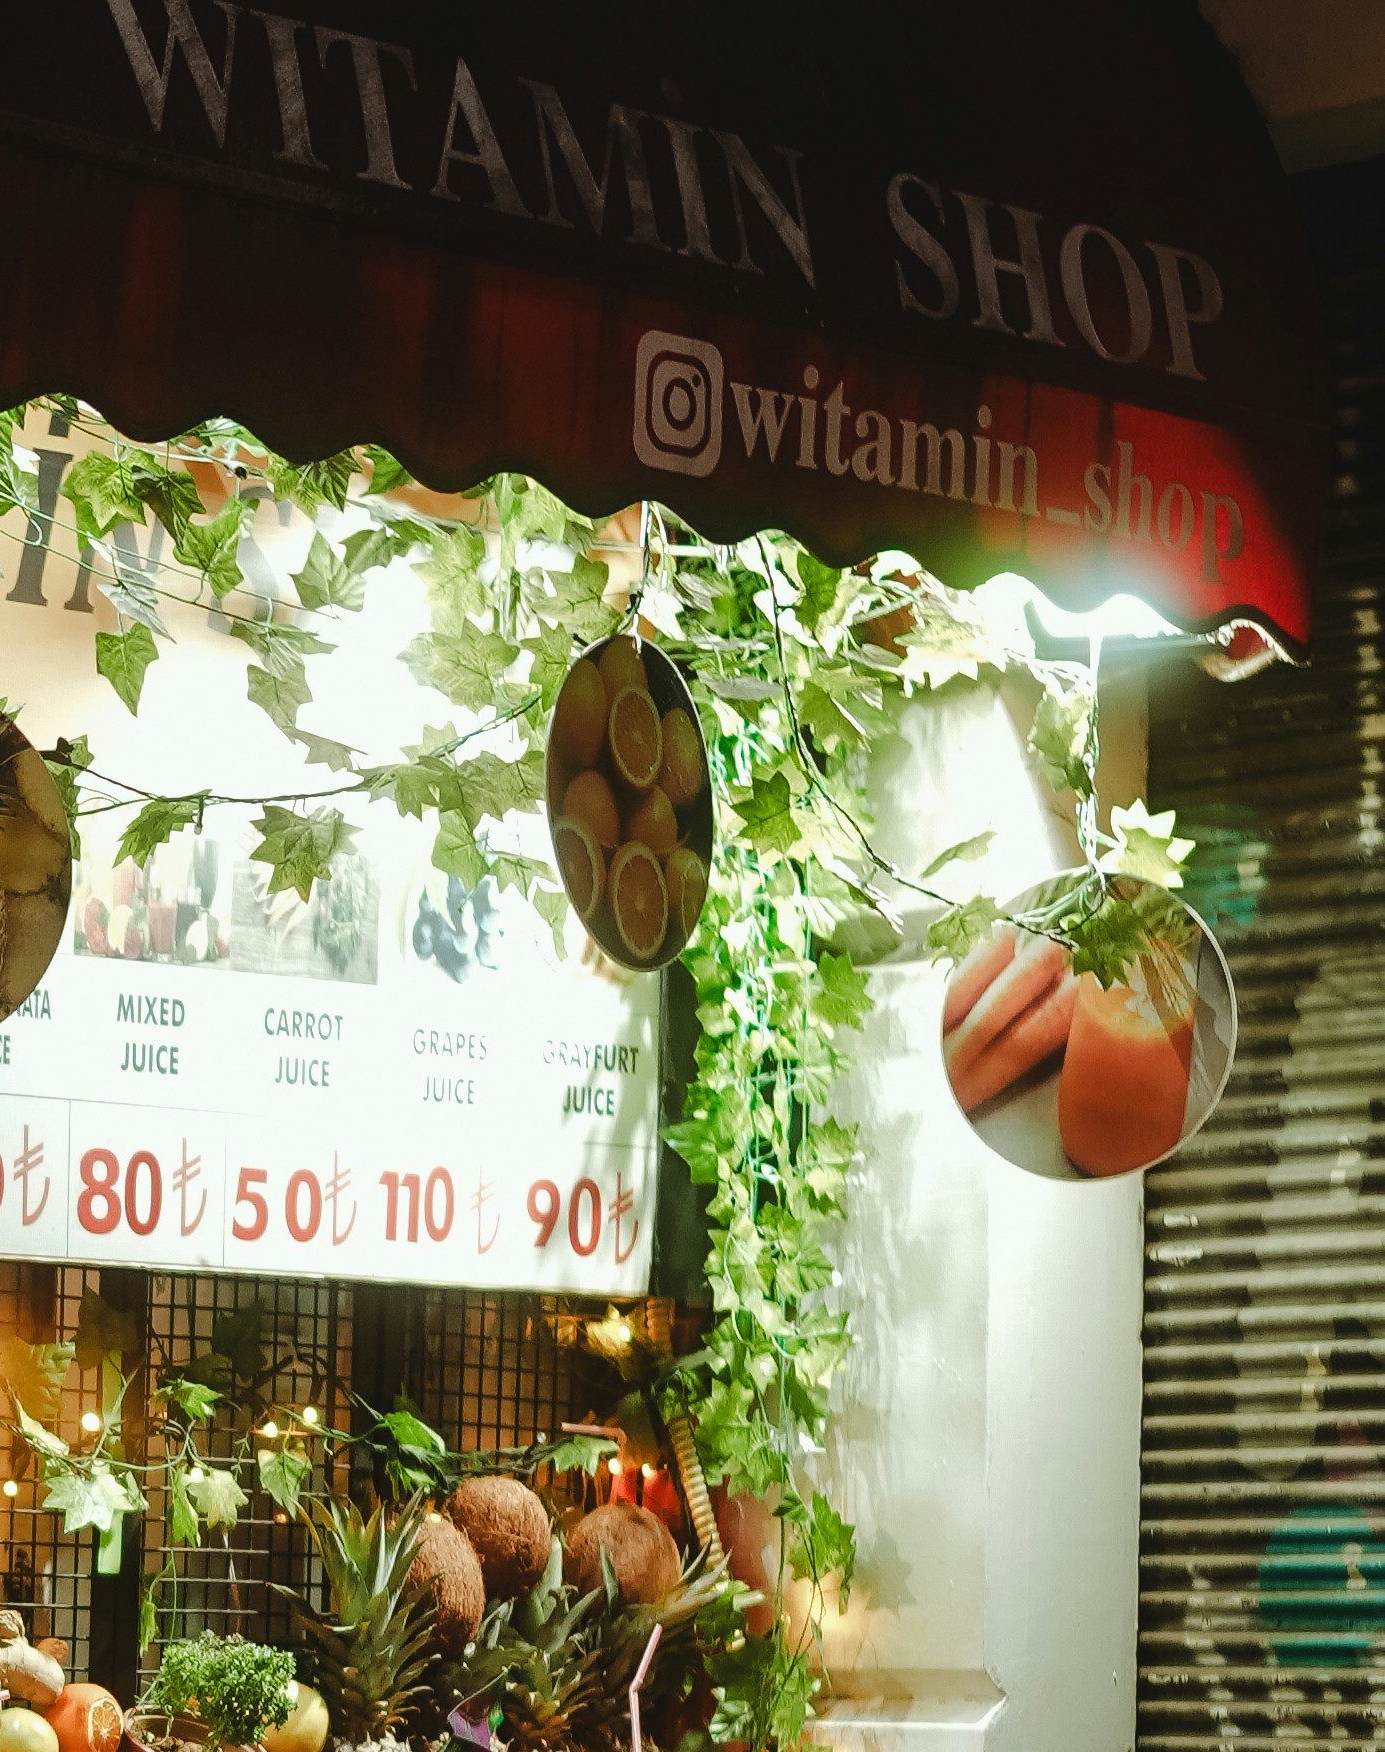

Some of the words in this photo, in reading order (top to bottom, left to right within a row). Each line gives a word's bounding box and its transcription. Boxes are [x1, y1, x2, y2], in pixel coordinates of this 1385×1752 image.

[887, 172, 1224, 382] SHOP
[729, 363, 1246, 582] witamin_shop
[116, 994, 186, 1028] MIXED
[264, 1006, 344, 1042] CARROT
[121, 1040, 180, 1077] JUICE
[412, 1029, 489, 1063] GRAPES
[543, 1040, 639, 1075] GRAYFURT
[274, 1054, 331, 1089] JUICE
[423, 1074, 477, 1108] JUICE
[563, 1082, 616, 1118] JUICE
